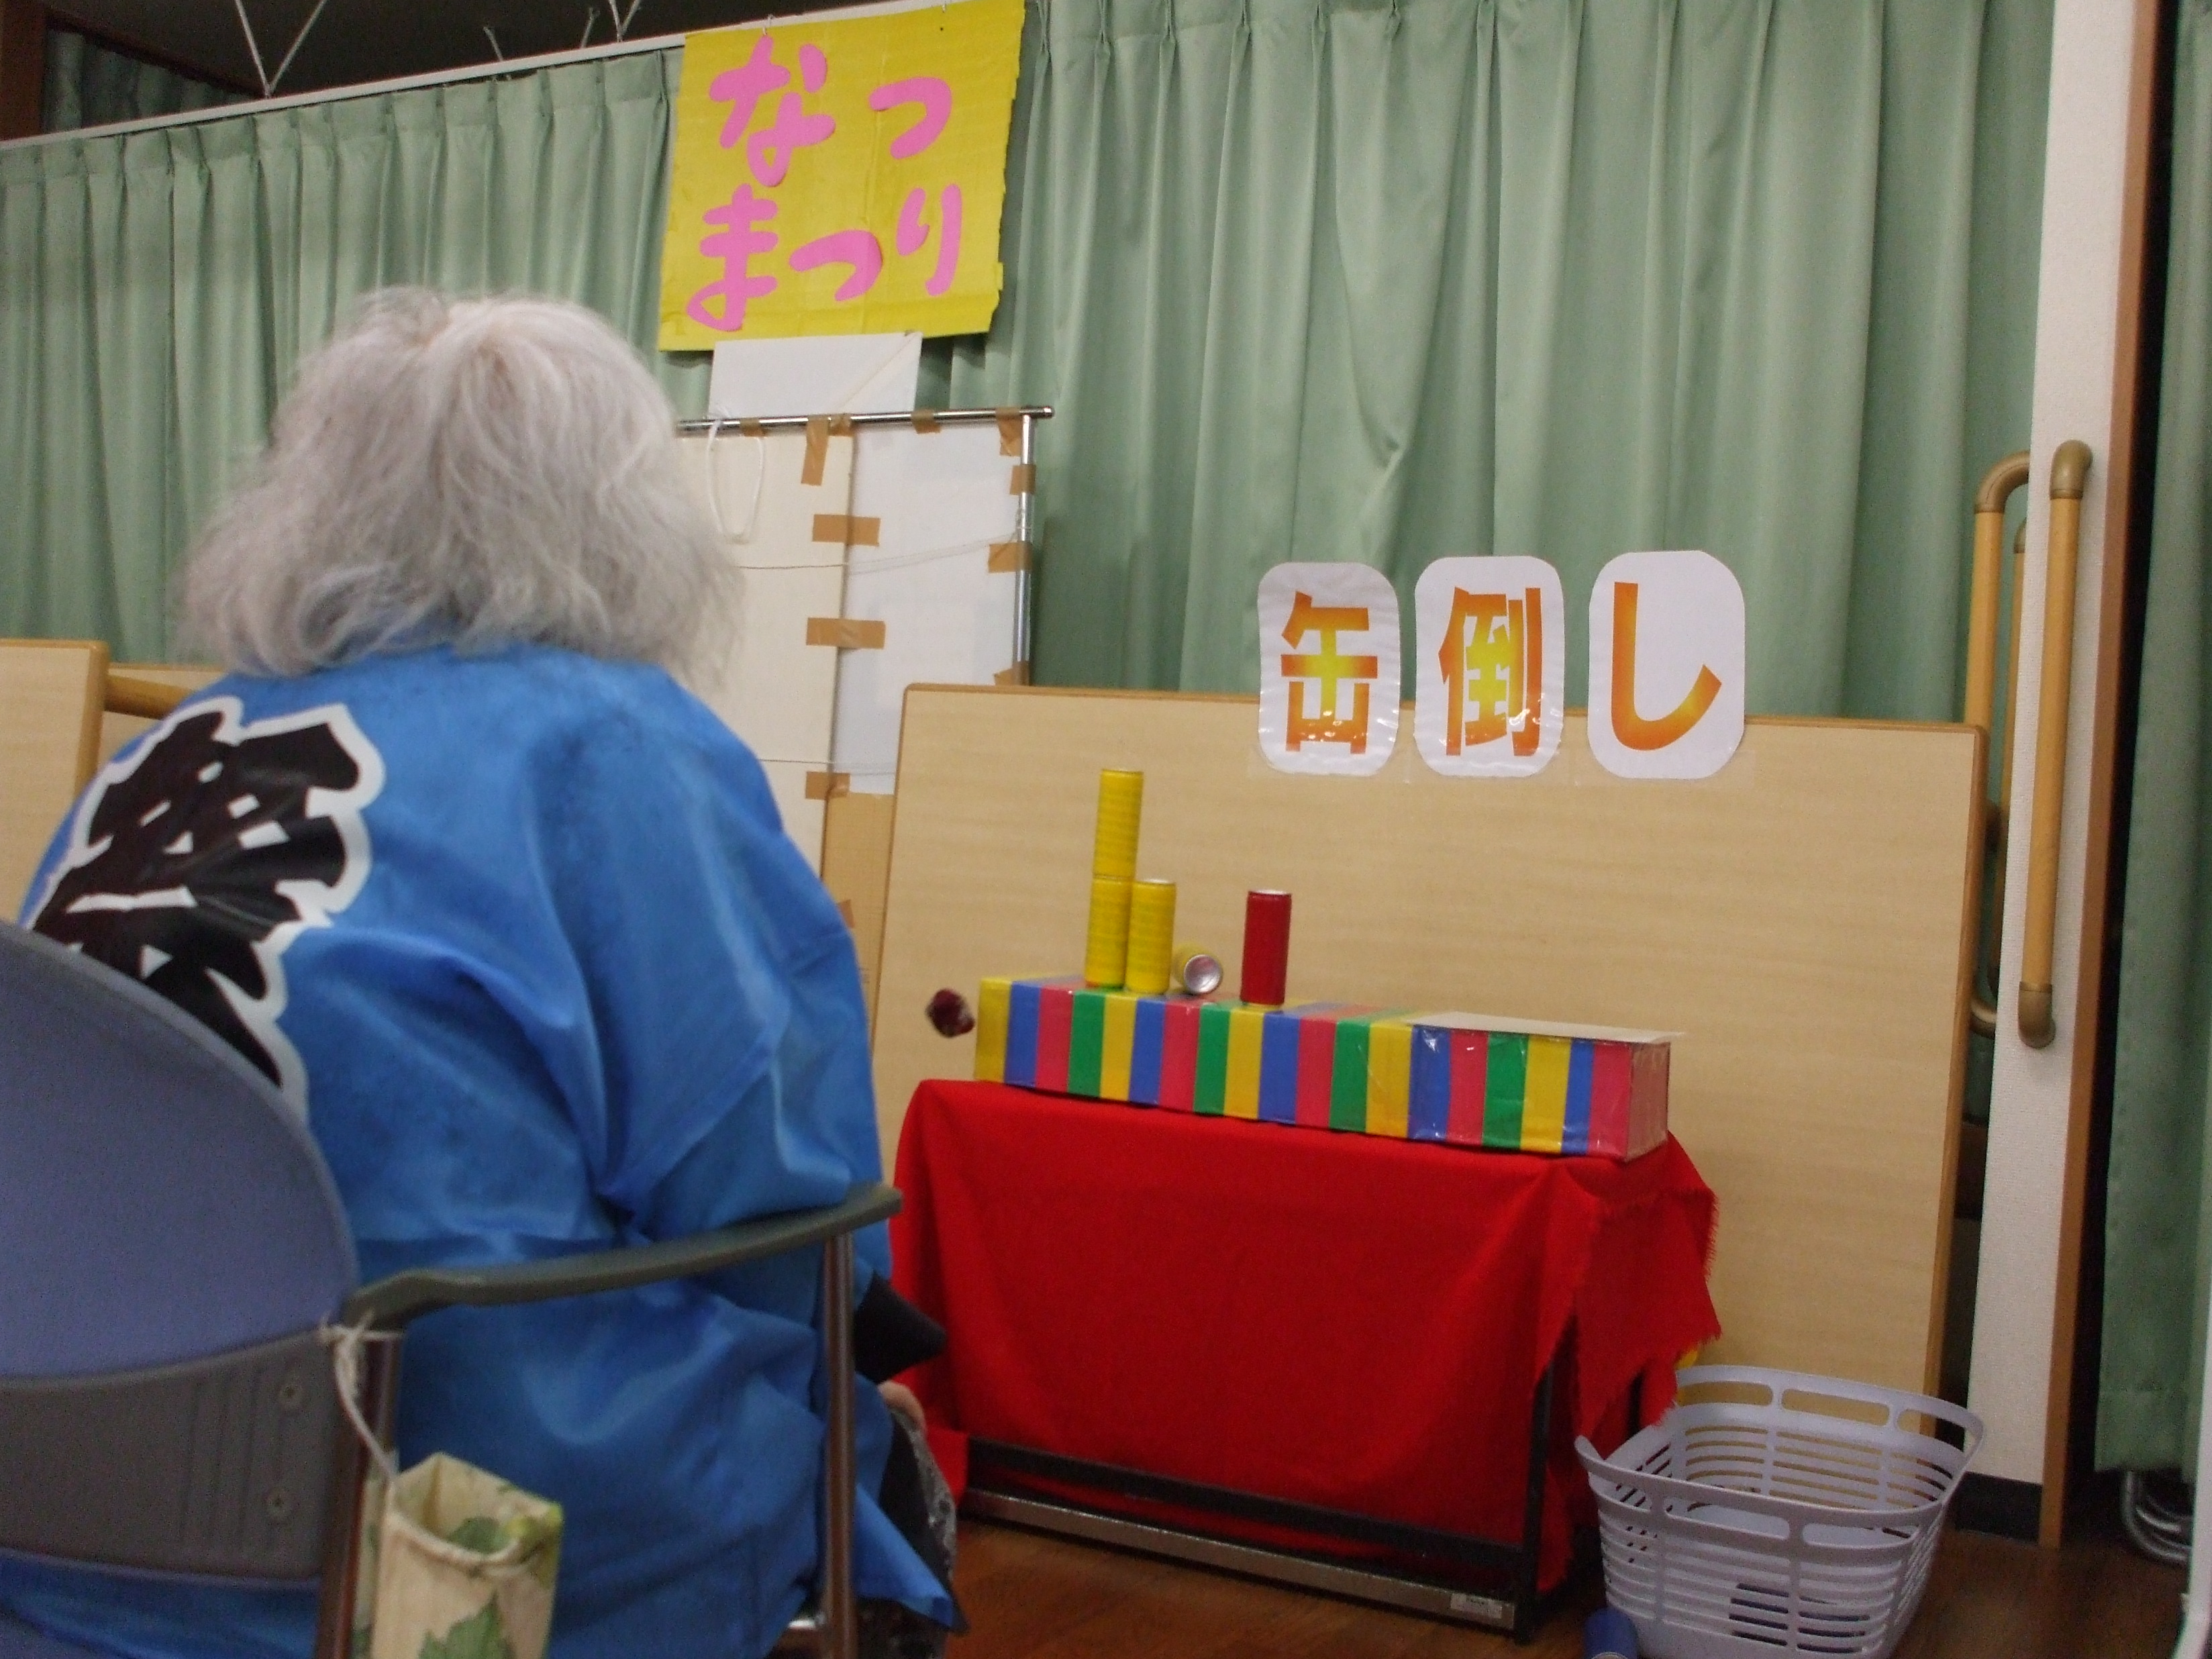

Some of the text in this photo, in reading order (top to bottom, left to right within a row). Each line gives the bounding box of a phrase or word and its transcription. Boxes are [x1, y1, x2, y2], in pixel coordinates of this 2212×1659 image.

[709, 34, 952, 187] なつ
[685, 183, 962, 332] まつり
[1280, 581, 1723, 757] 缶倒し
